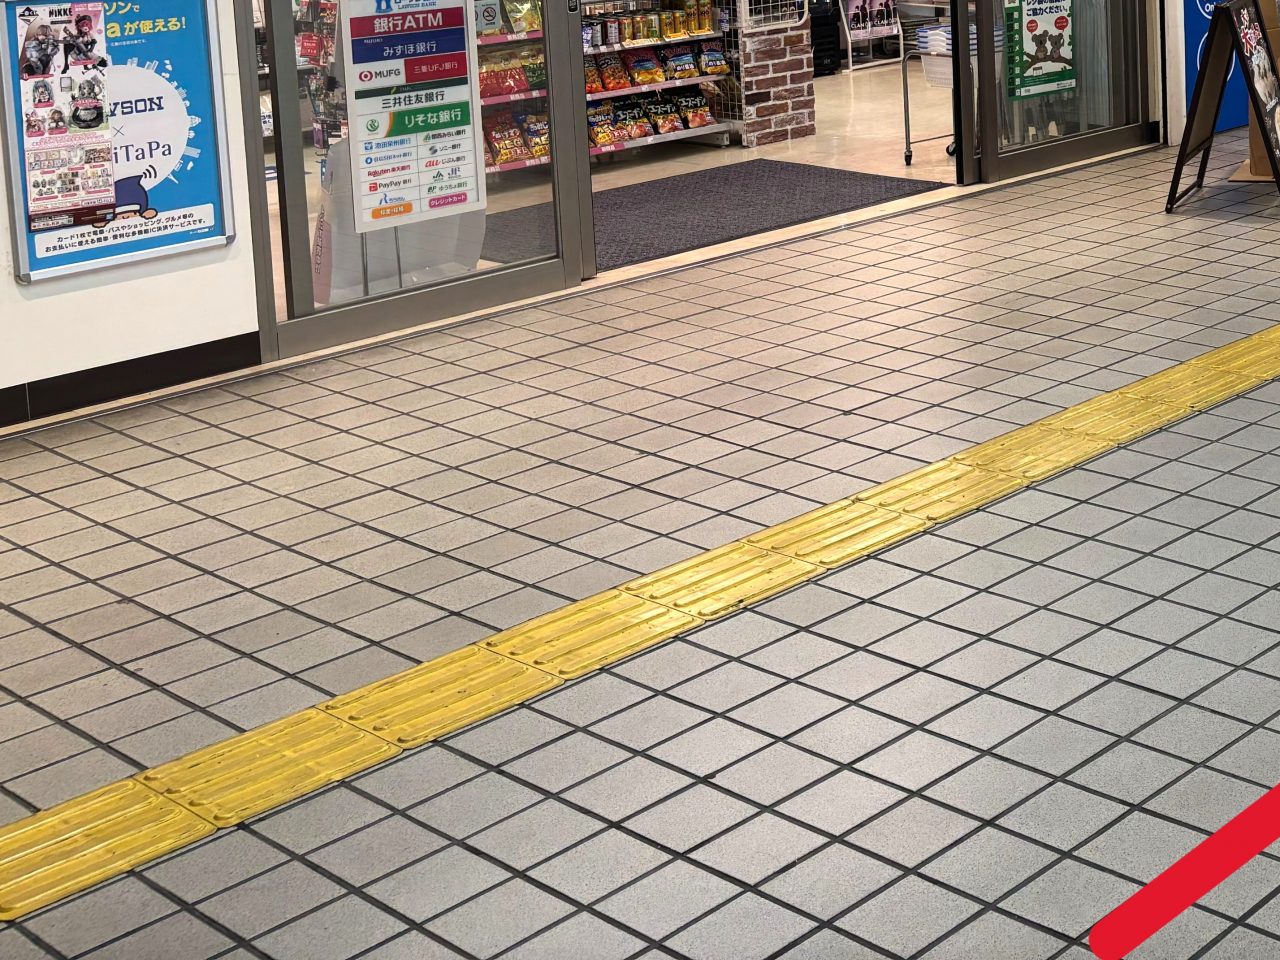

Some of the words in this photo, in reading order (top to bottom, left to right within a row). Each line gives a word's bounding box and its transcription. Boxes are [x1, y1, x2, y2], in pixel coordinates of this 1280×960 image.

[373, 11, 443, 33] 銀行ATM
[383, 41, 437, 57] みずほ銀行
[374, 68, 401, 79] MUFG
[413, 61, 458, 74] 三菱UFJ銀行
[381, 90, 446, 109] 三井住友銀行
[404, 108, 462, 128] りそな銀行
[113, 141, 173, 164] iTaPa
[378, 180, 402, 190] PayPay
[430, 194, 466, 207] クレジットカード
